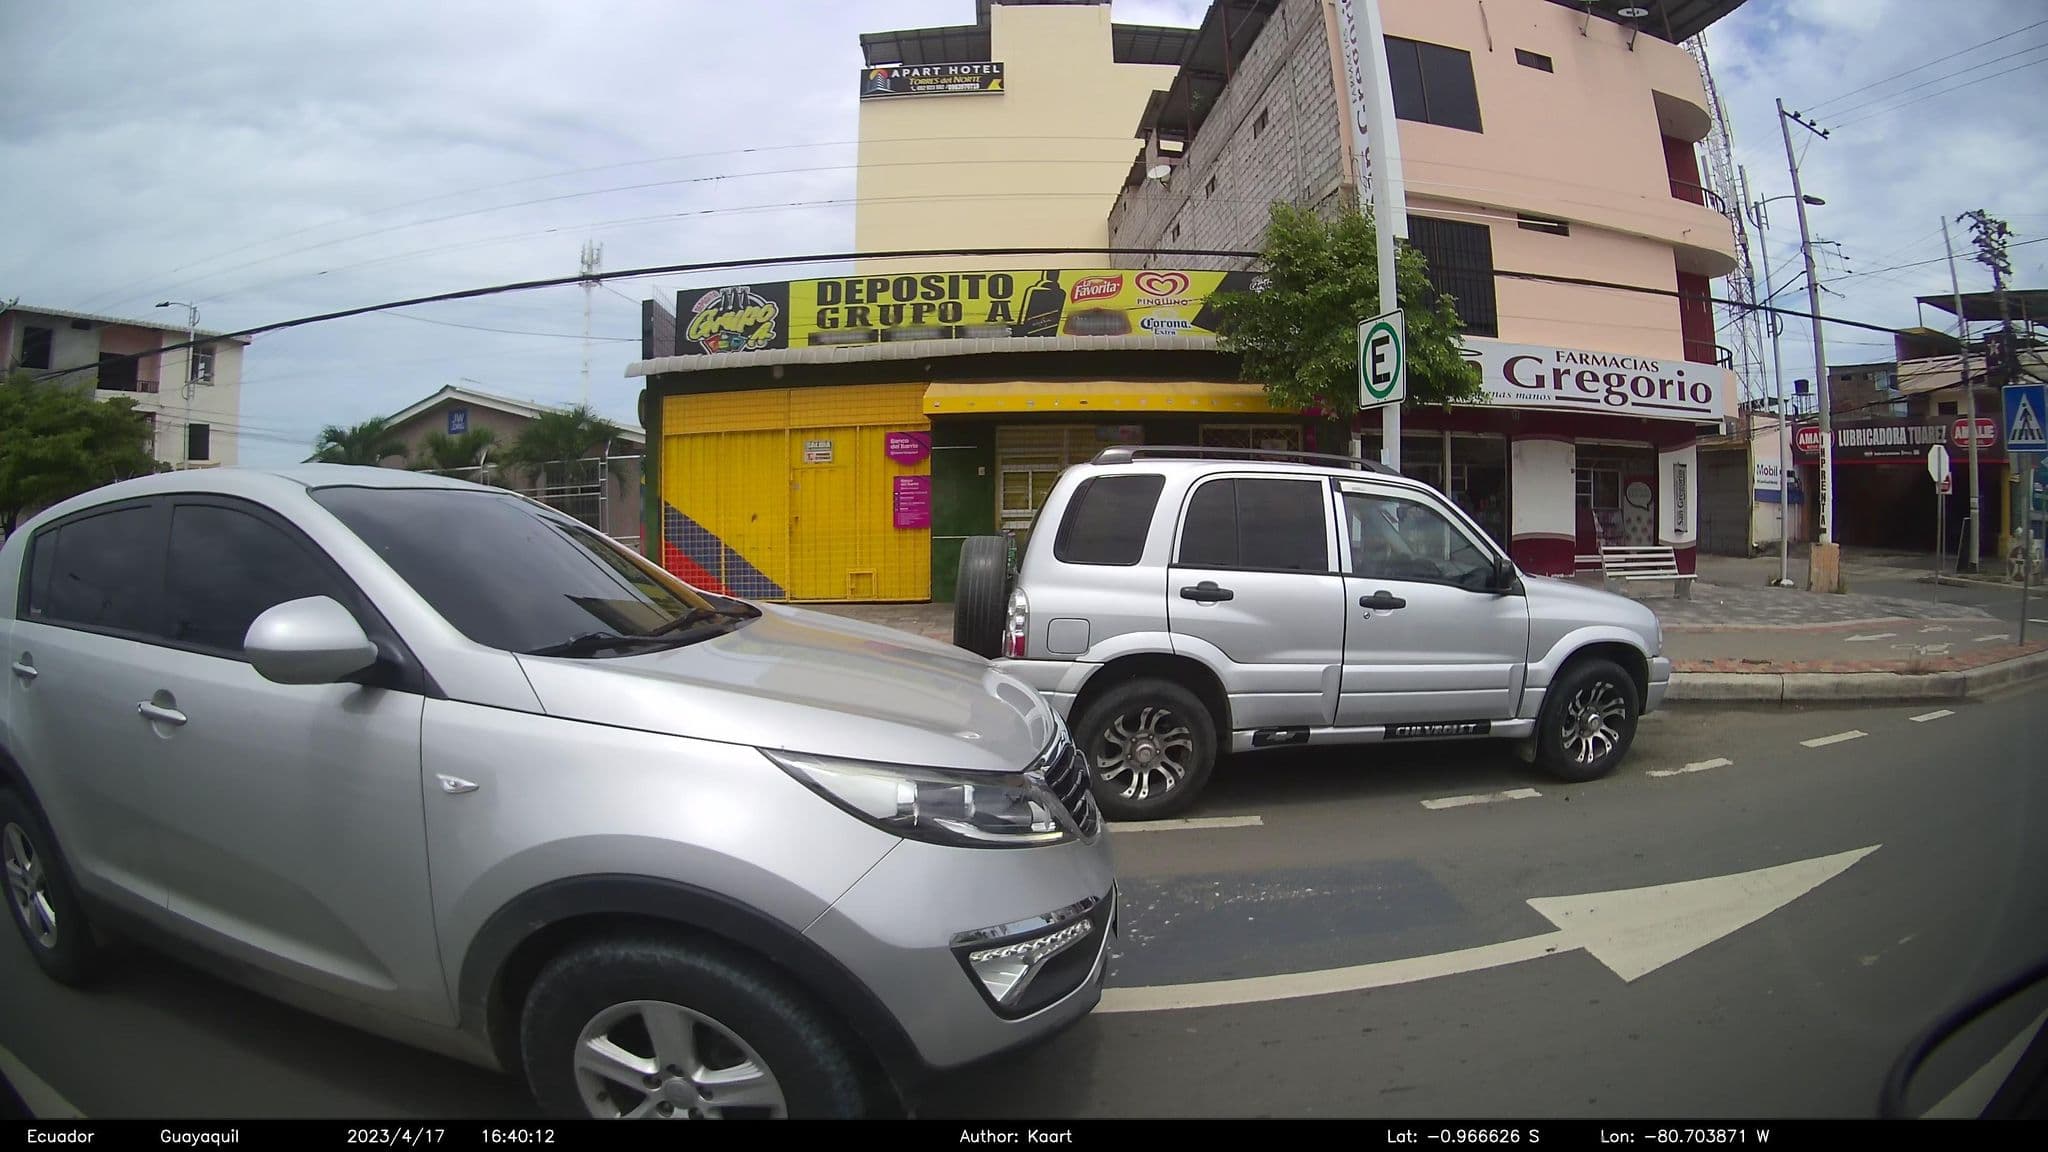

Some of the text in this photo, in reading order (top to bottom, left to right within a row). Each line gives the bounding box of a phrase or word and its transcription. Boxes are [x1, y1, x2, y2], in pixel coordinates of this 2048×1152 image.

[891, 65, 1000, 78] APART HOTEL
[816, 273, 1014, 306] DEPOSITO
[1074, 281, 1117, 299] Favorita
[816, 300, 1015, 329] GRUPO A
[1140, 317, 1188, 331] Corona
[1371, 335, 1390, 385] E
[1556, 350, 1660, 373] FARMACIAS
[1502, 355, 1713, 406] Gregorio
[1838, 425, 1947, 447] LUBRICADORA TUAREZ
[1756, 464, 1778, 477] Mobil
